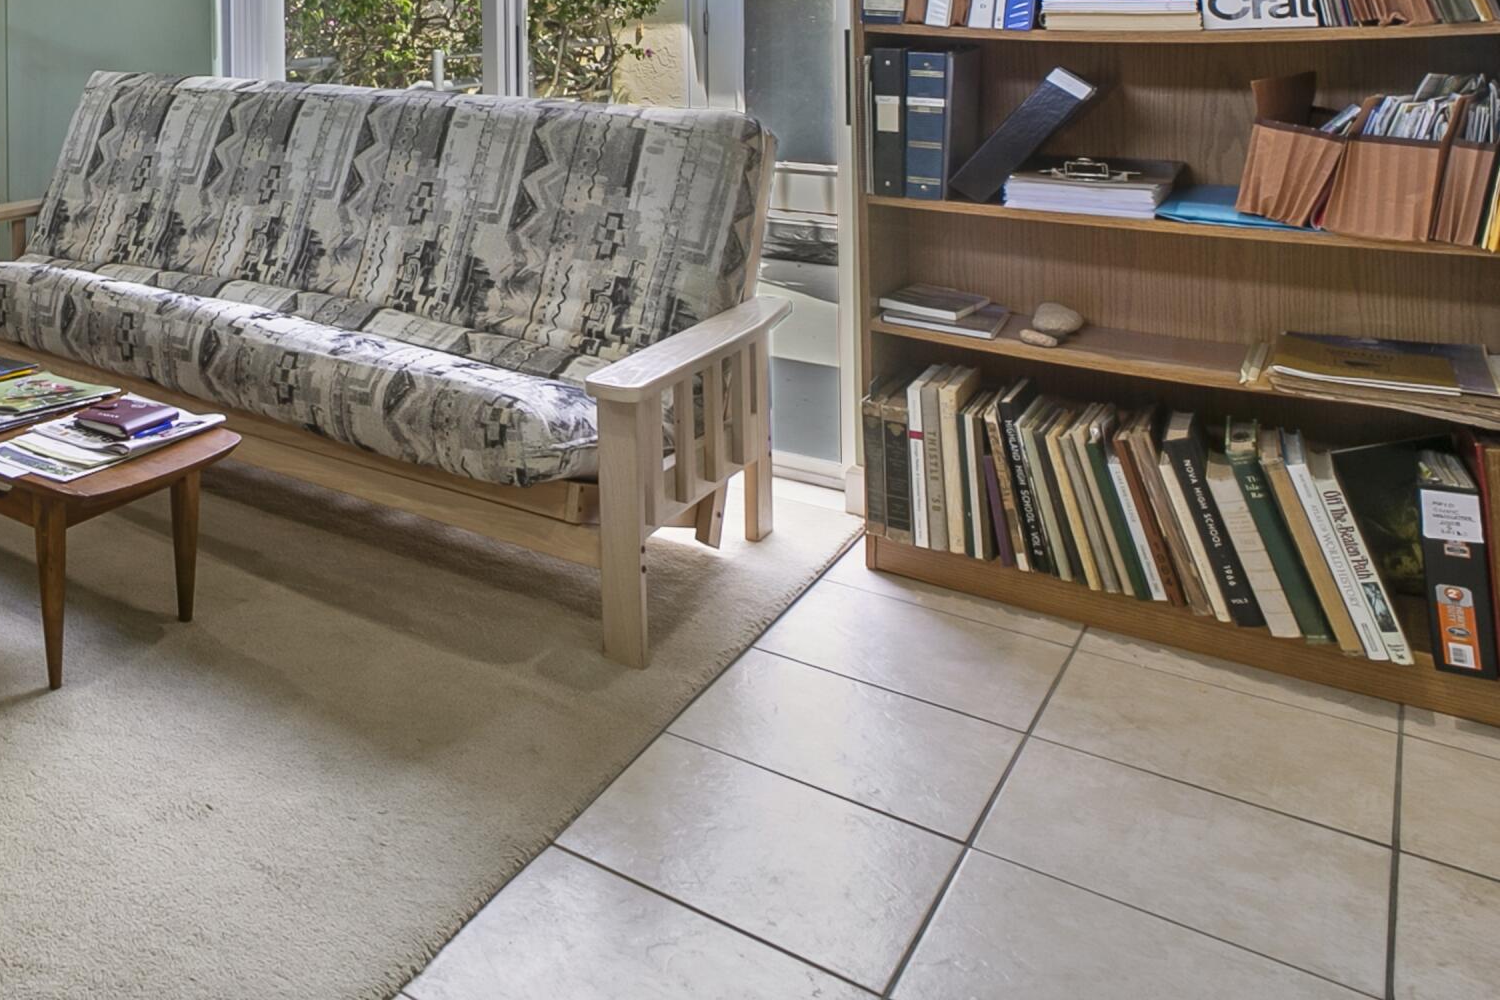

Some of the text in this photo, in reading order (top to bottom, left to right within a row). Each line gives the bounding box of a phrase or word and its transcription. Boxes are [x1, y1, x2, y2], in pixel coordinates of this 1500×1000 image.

[927, 430, 939, 481] THISTLE
[1004, 419, 1020, 461] HIGHLAND
[1015, 465, 1027, 486] HIGH
[1020, 489, 1035, 523] SCHOOL
[1182, 458, 1223, 549] NOVA HIGH SCHOOL
[1323, 487, 1373, 581] Off The Beaten Path
[1222, 563, 1238, 588] 1966
[1322, 532, 1345, 570] WORLD
[1336, 567, 1362, 611] HISTORY
[1447, 587, 1459, 600] 2
